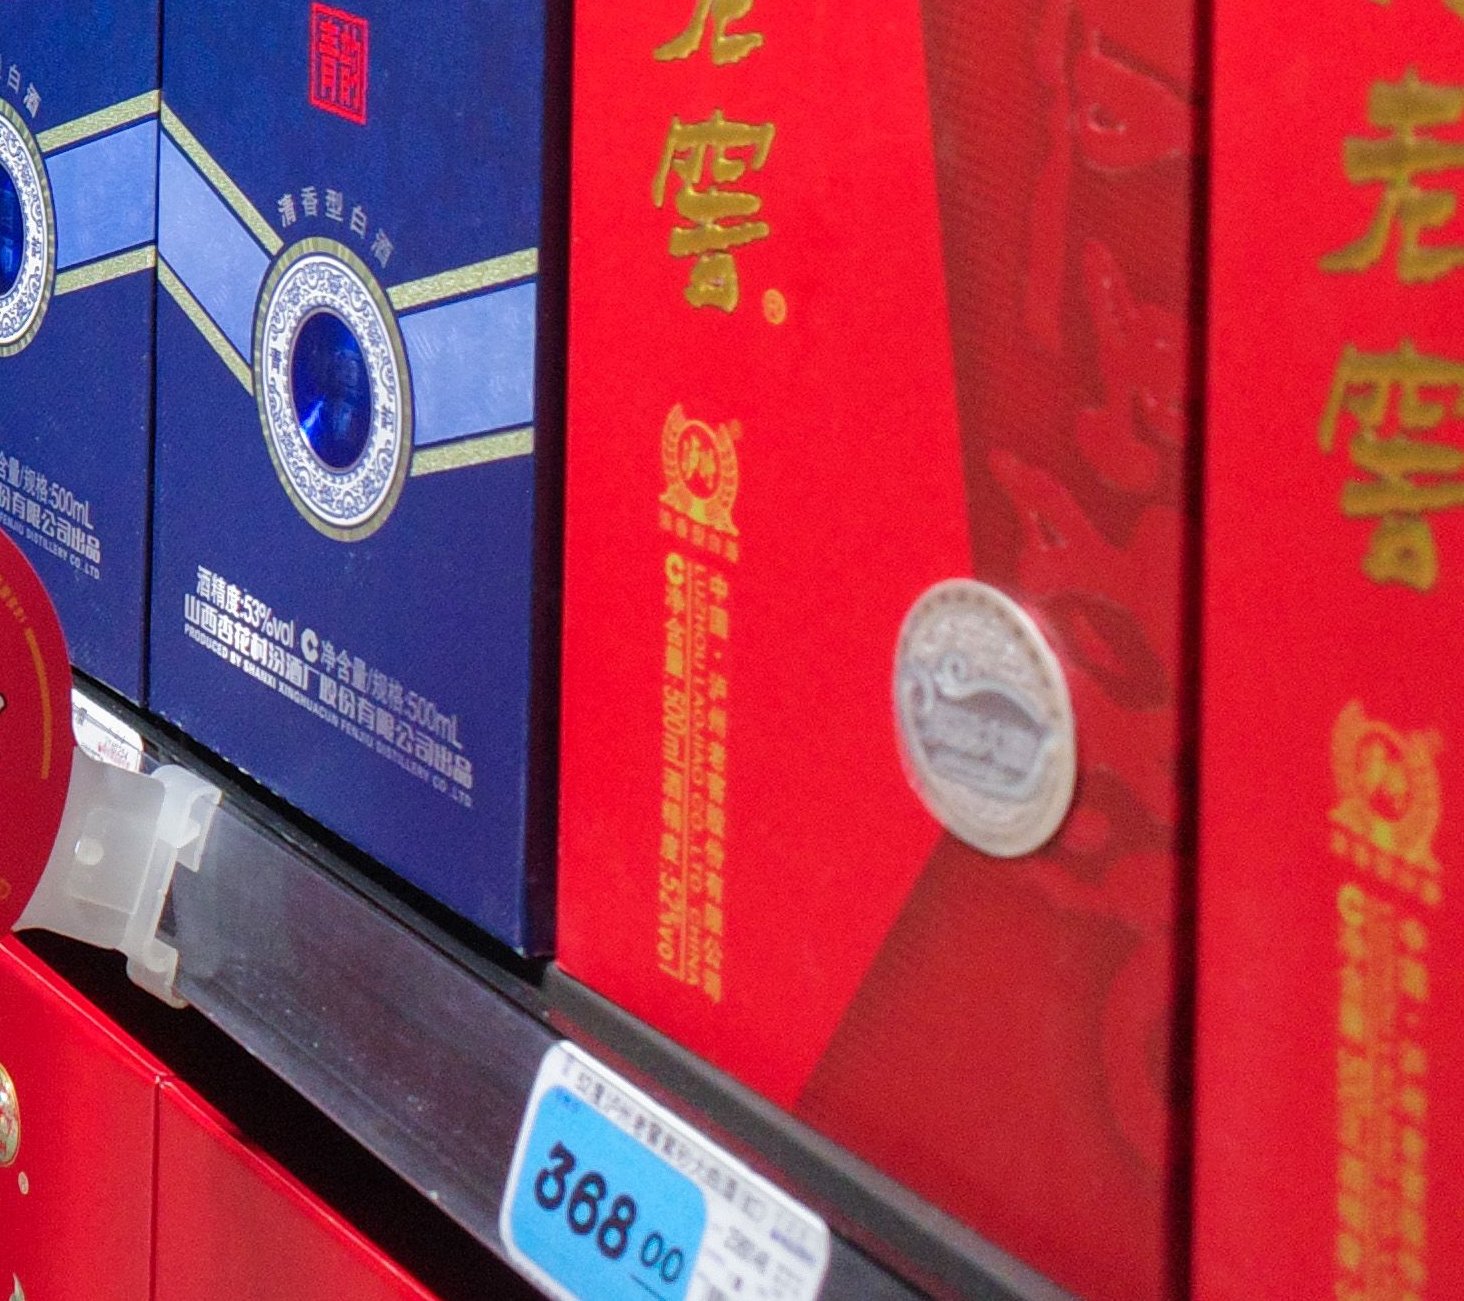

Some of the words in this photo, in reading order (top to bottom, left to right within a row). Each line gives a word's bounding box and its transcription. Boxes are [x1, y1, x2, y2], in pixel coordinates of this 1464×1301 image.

[276, 185, 395, 270] 清香型白酒
[184, 622, 229, 660] PRODUCED
[195, 564, 295, 649] 酒精度:53%vol
[184, 592, 475, 790] 山西杏花村汾酒厂股份有限公司出品
[533, 1140, 638, 1261] 368
[639, 1230, 685, 1285] 00
